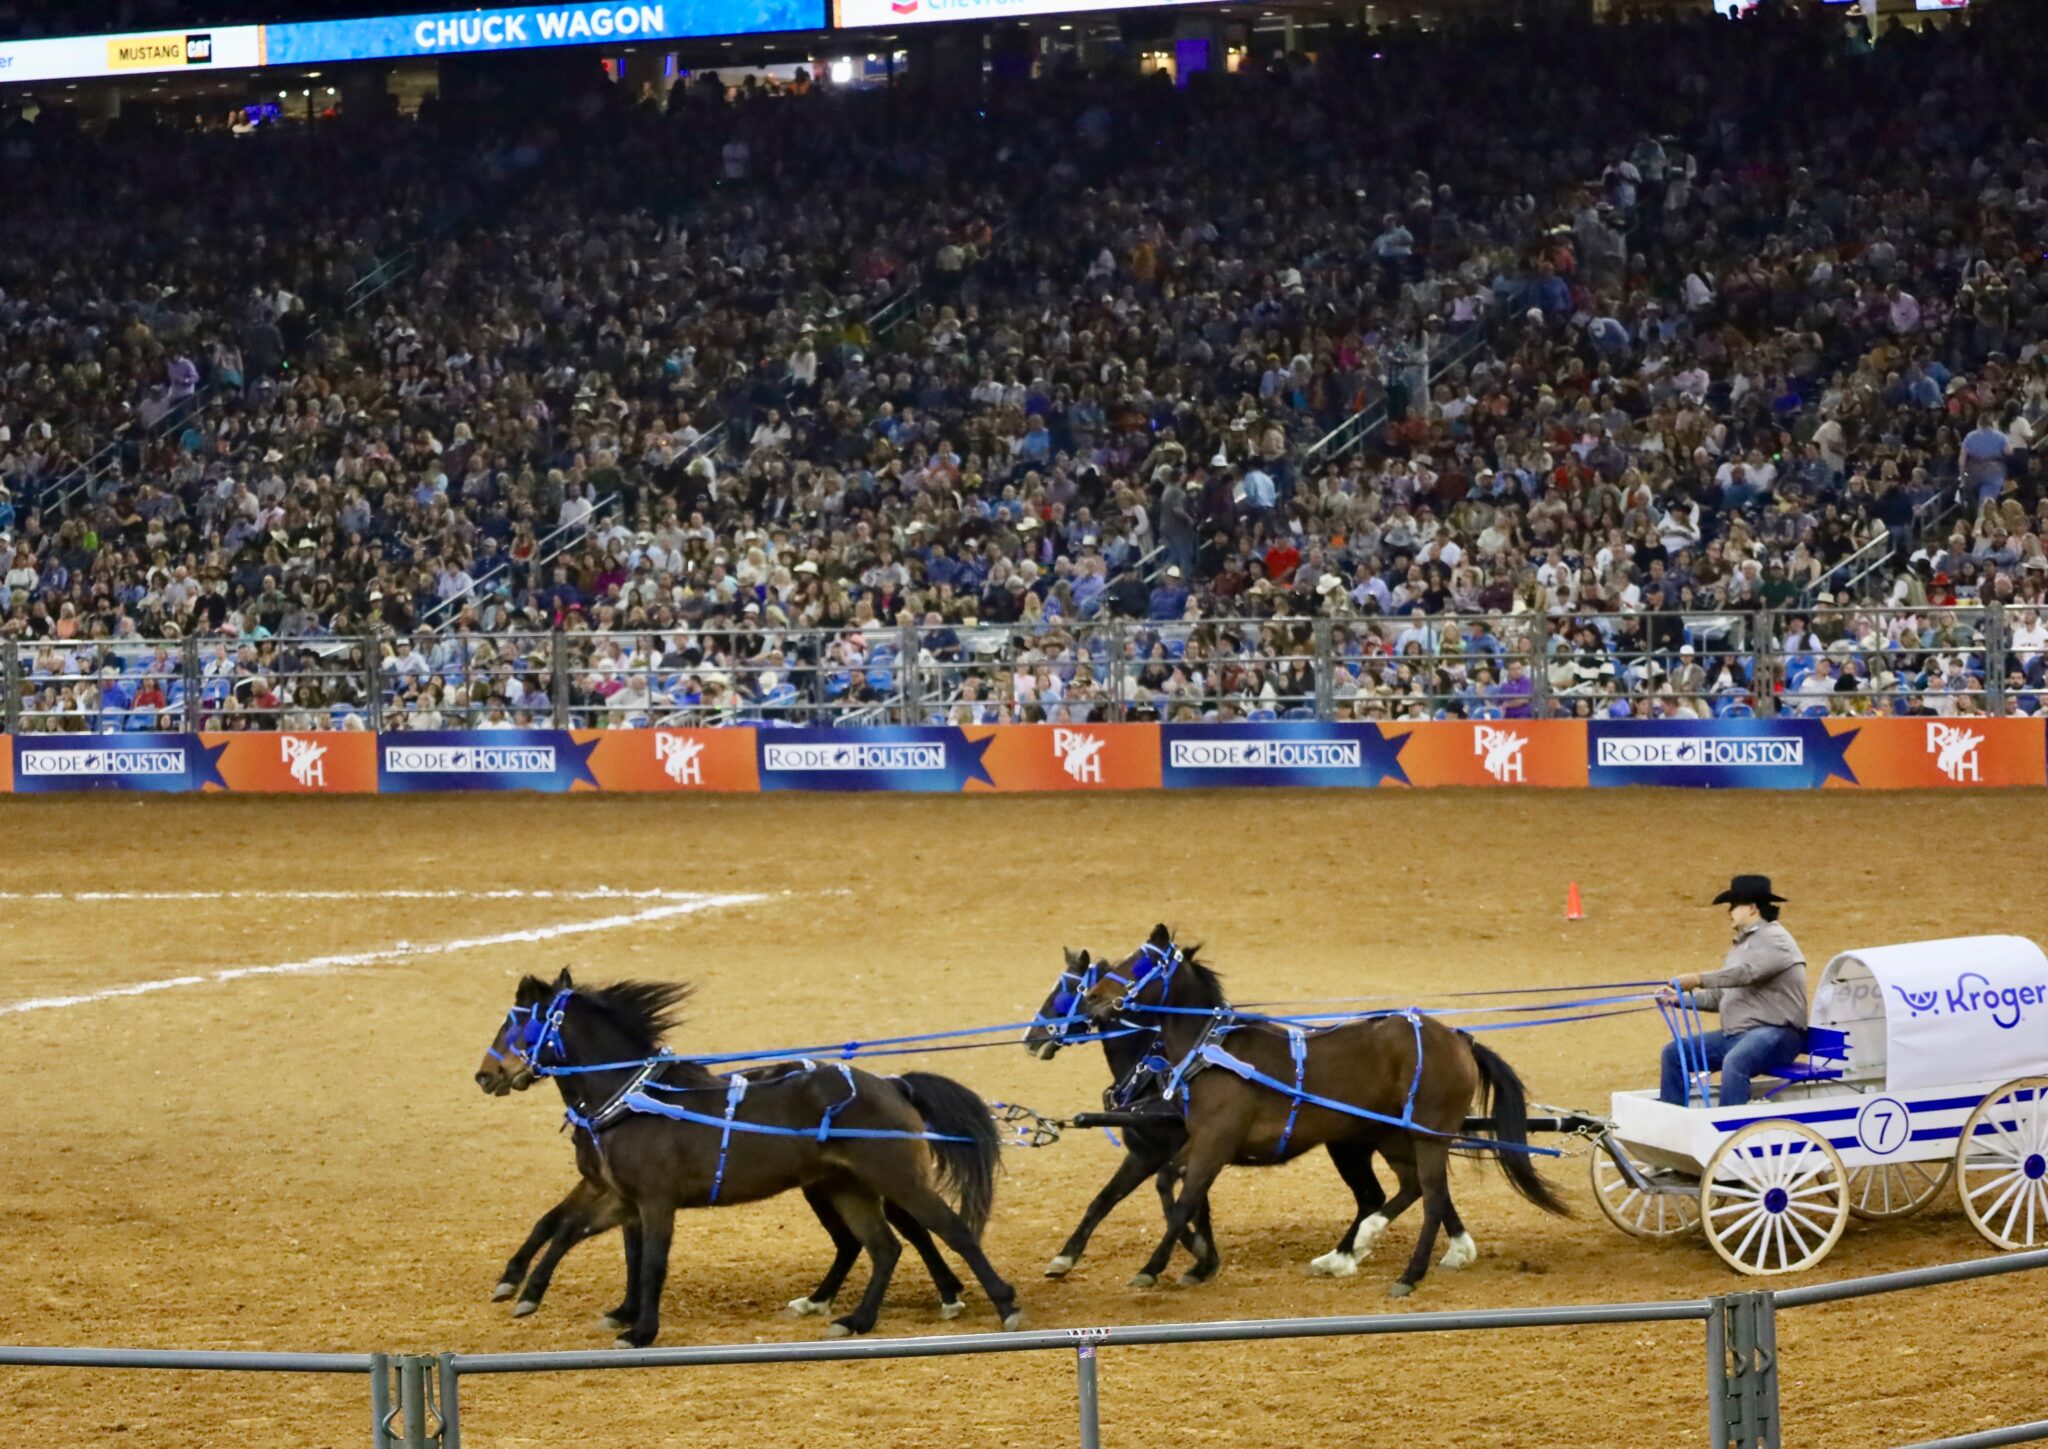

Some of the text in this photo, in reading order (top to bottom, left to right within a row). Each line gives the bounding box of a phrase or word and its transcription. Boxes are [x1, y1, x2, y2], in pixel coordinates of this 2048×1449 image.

[415, 5, 664, 47] CHUCK WAGON
[119, 45, 180, 60] MUSTANG
[1945, 972, 2047, 1029] Kroger
[1873, 1112, 1893, 1145] 7
